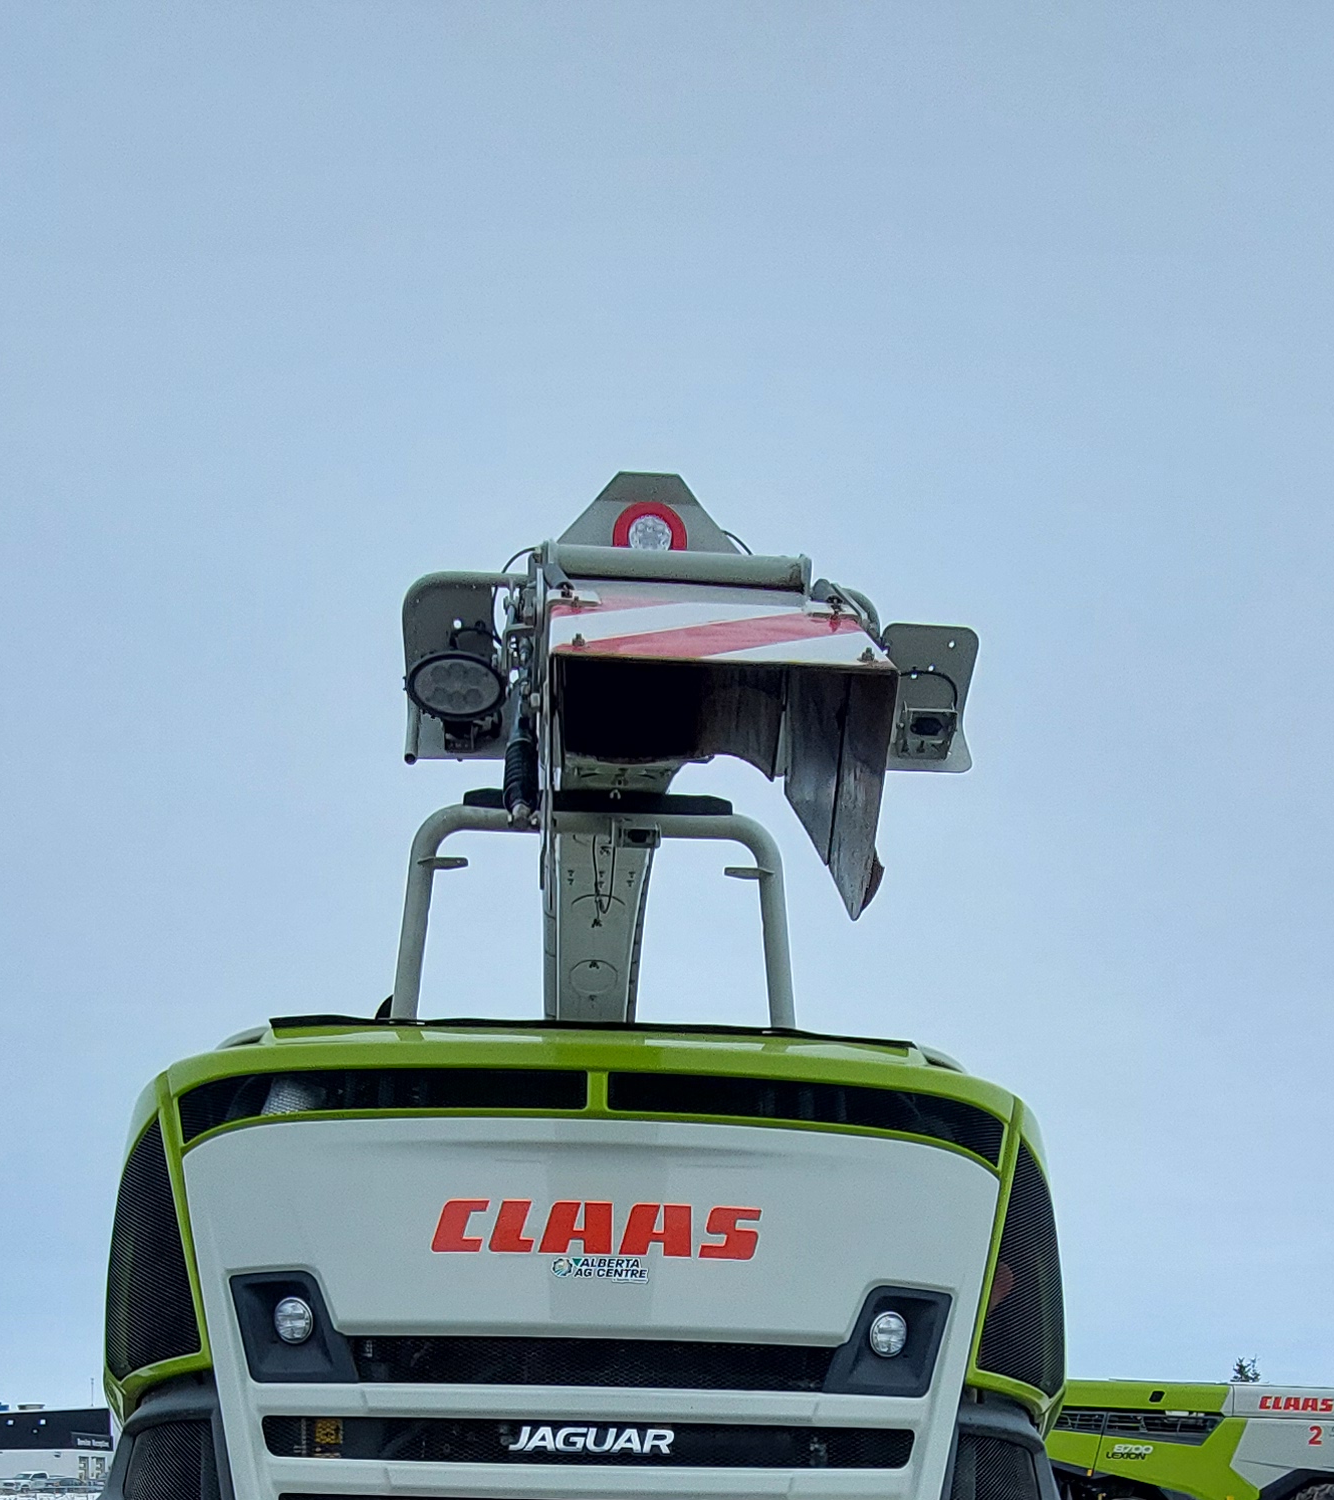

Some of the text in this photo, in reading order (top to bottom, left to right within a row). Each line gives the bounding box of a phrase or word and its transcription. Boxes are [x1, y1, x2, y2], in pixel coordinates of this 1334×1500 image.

[430, 1198, 762, 1261] CLAAS
[580, 1258, 640, 1268] ALBERTA
[574, 1268, 647, 1278] AG CENTRE
[1258, 1395, 1334, 1412] CLAAS
[508, 1426, 675, 1454] JAGUAR
[1308, 1425, 1322, 1445] 2
[1106, 1452, 1146, 1460] LEXION
